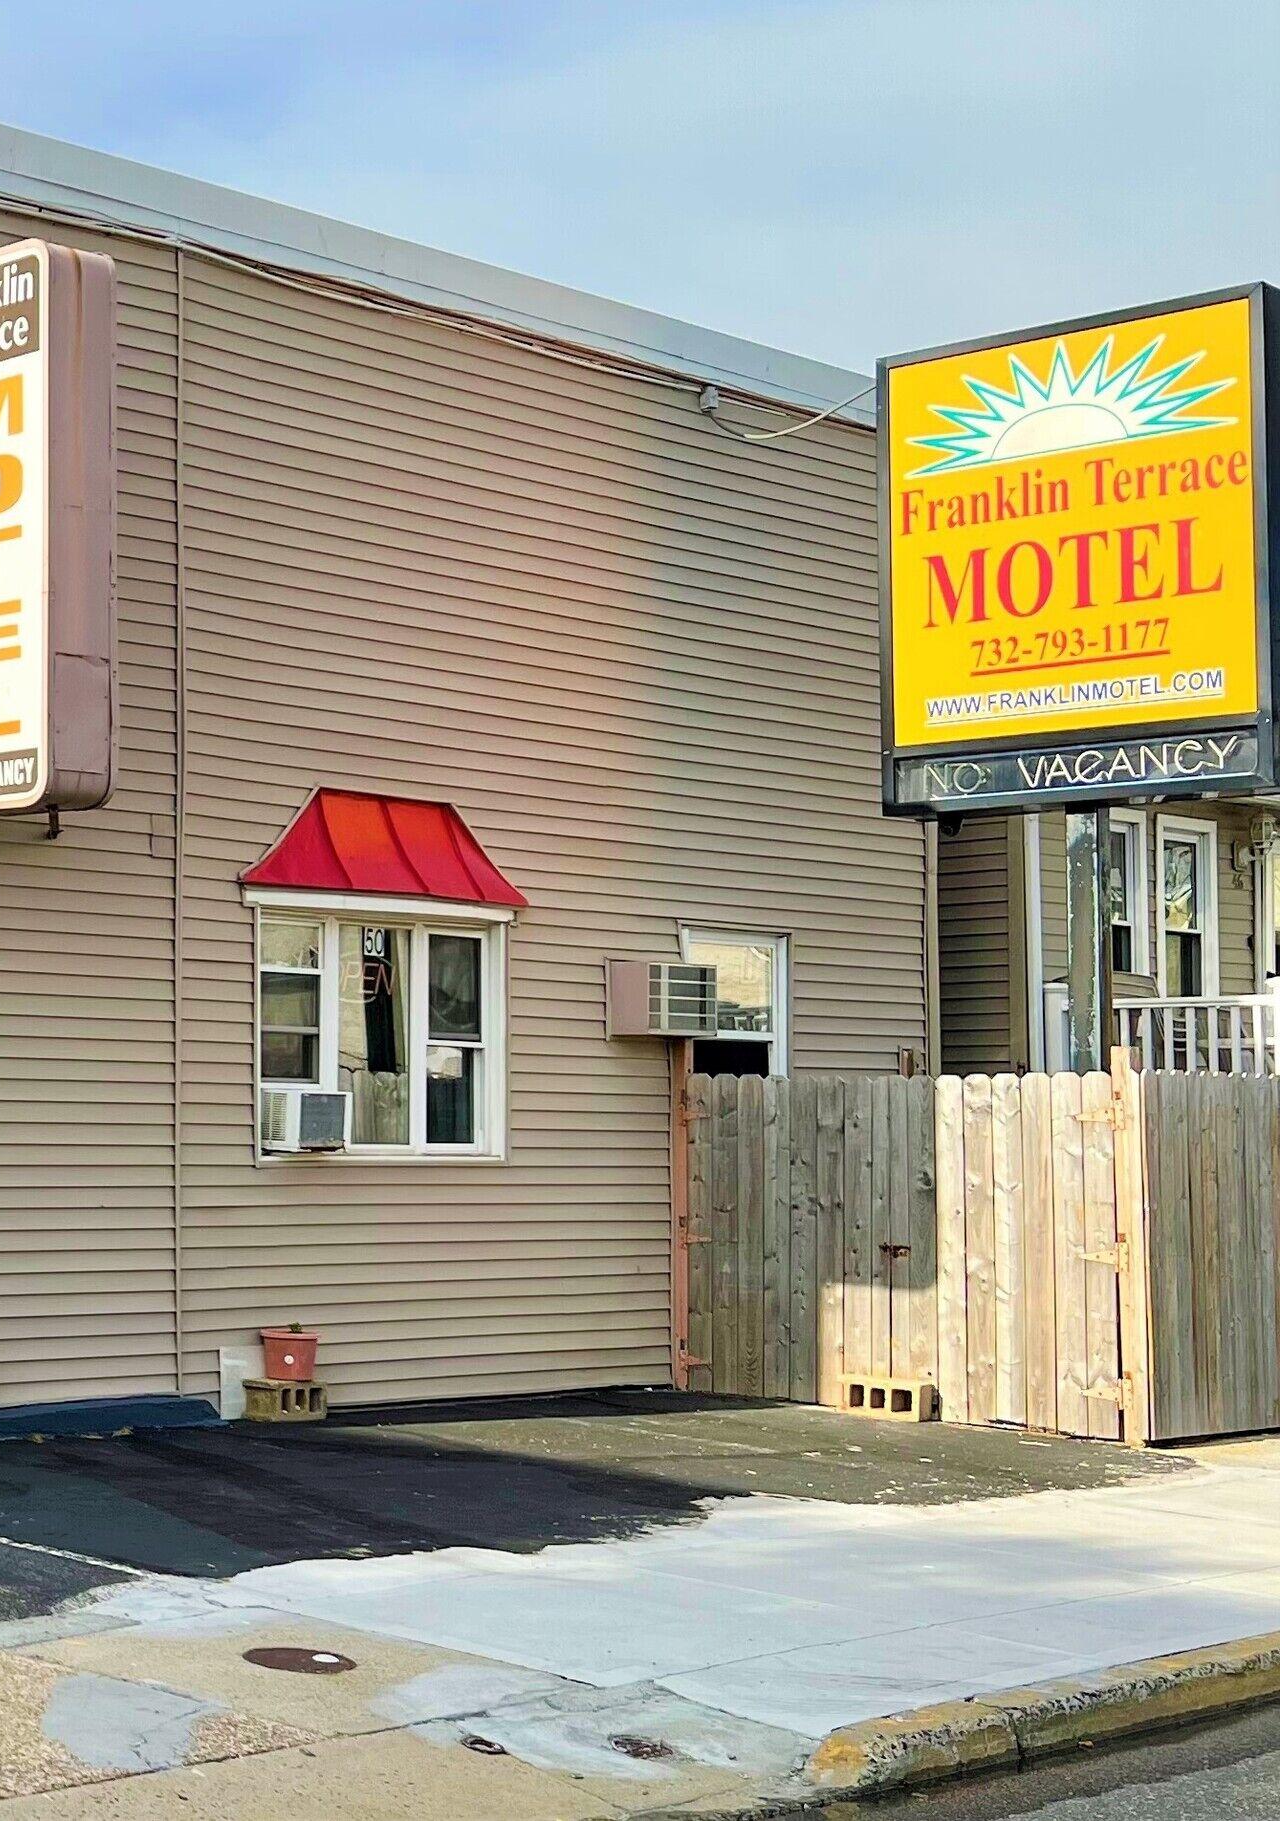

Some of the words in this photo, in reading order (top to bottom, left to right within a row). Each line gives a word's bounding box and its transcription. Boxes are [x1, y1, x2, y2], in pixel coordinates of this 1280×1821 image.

[899, 469, 1070, 536] Franklin
[1085, 450, 1249, 507] Terrace
[922, 517, 1224, 629] MOTEL
[970, 618, 1170, 668] 732-793-1177
[927, 669, 1224, 717] WWW.FRANKLINMOTEL.COM
[924, 761, 988, 794] NO
[1017, 735, 1238, 789] VACANCY
[366, 928, 385, 955] 50
[341, 961, 396, 995] PEN
